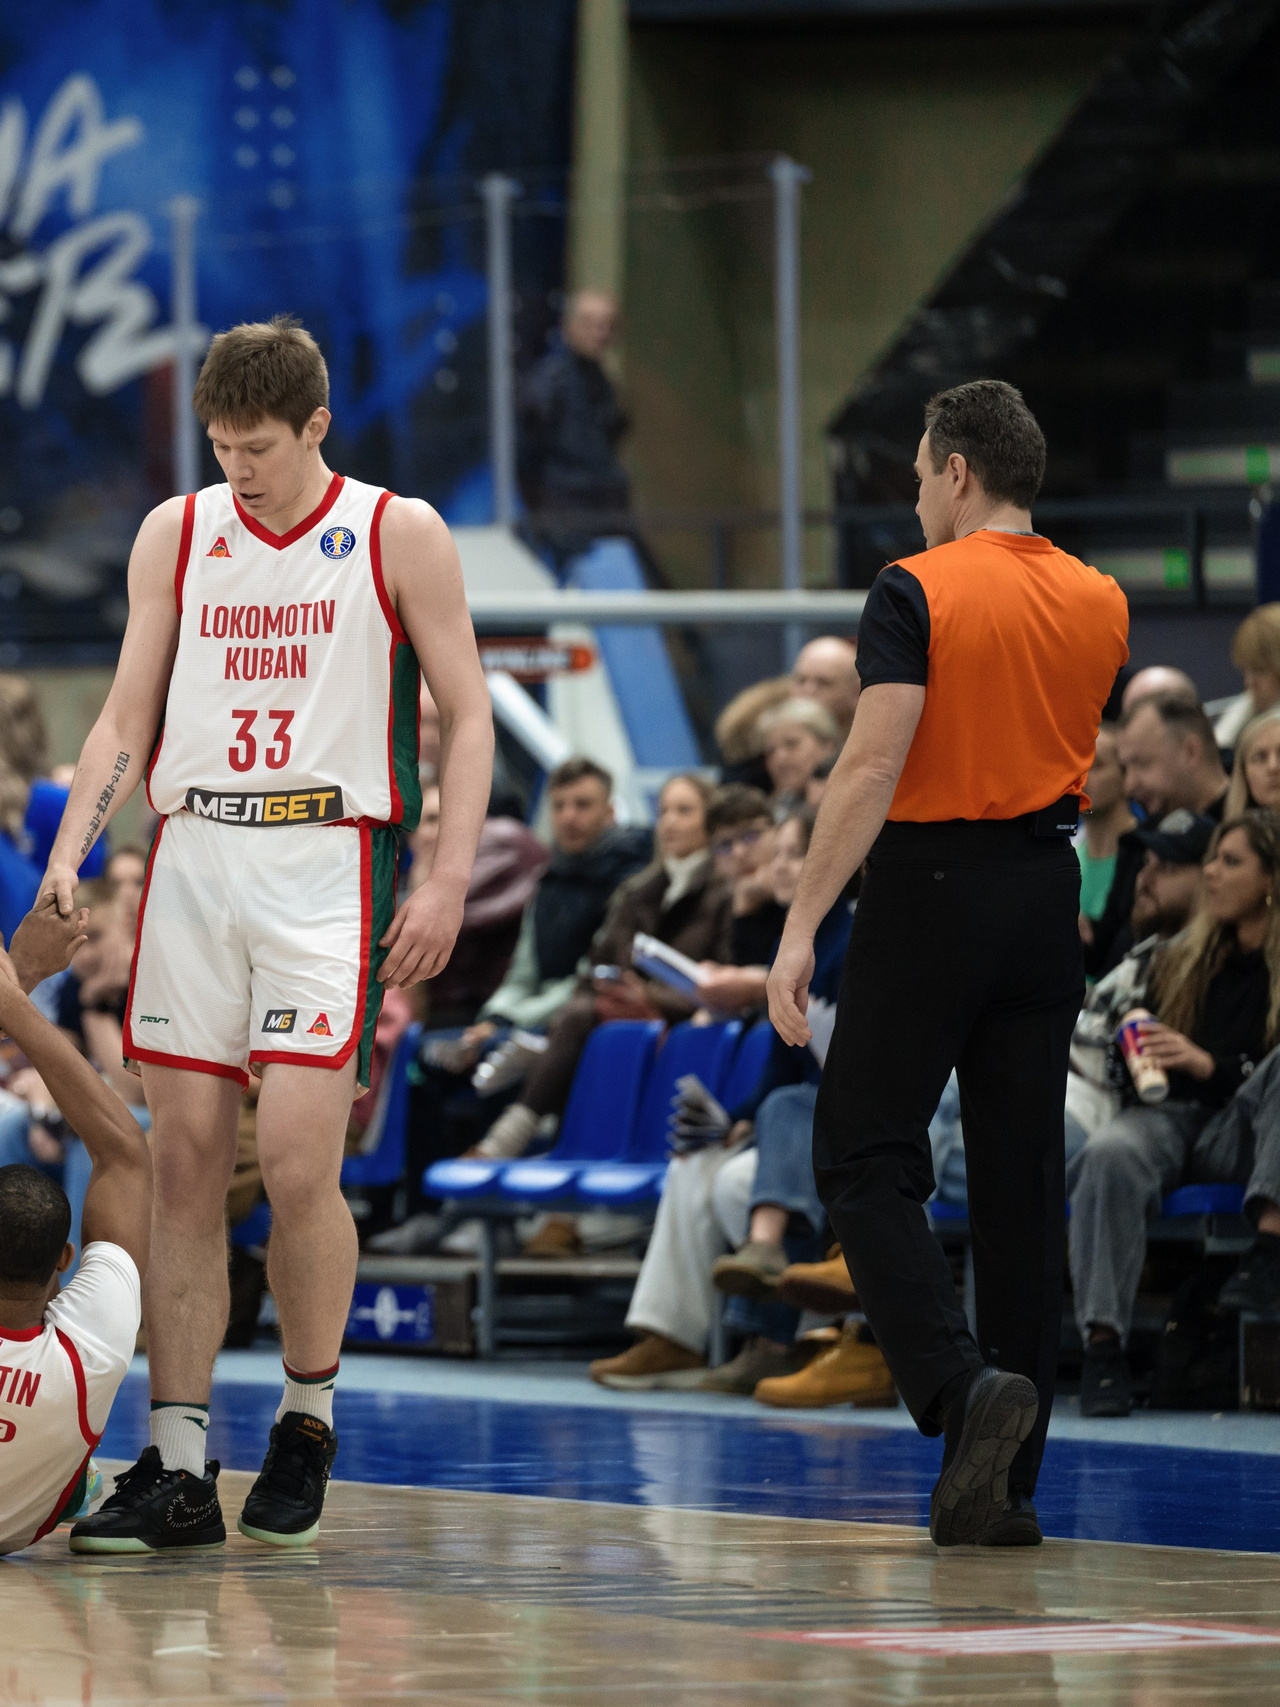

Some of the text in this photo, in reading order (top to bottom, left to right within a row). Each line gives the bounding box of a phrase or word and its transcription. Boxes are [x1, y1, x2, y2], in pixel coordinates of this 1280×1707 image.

[199, 599, 336, 640] LOKOMOTIV
[223, 644, 307, 681] KUBAN
[228, 709, 295, 773] 33
